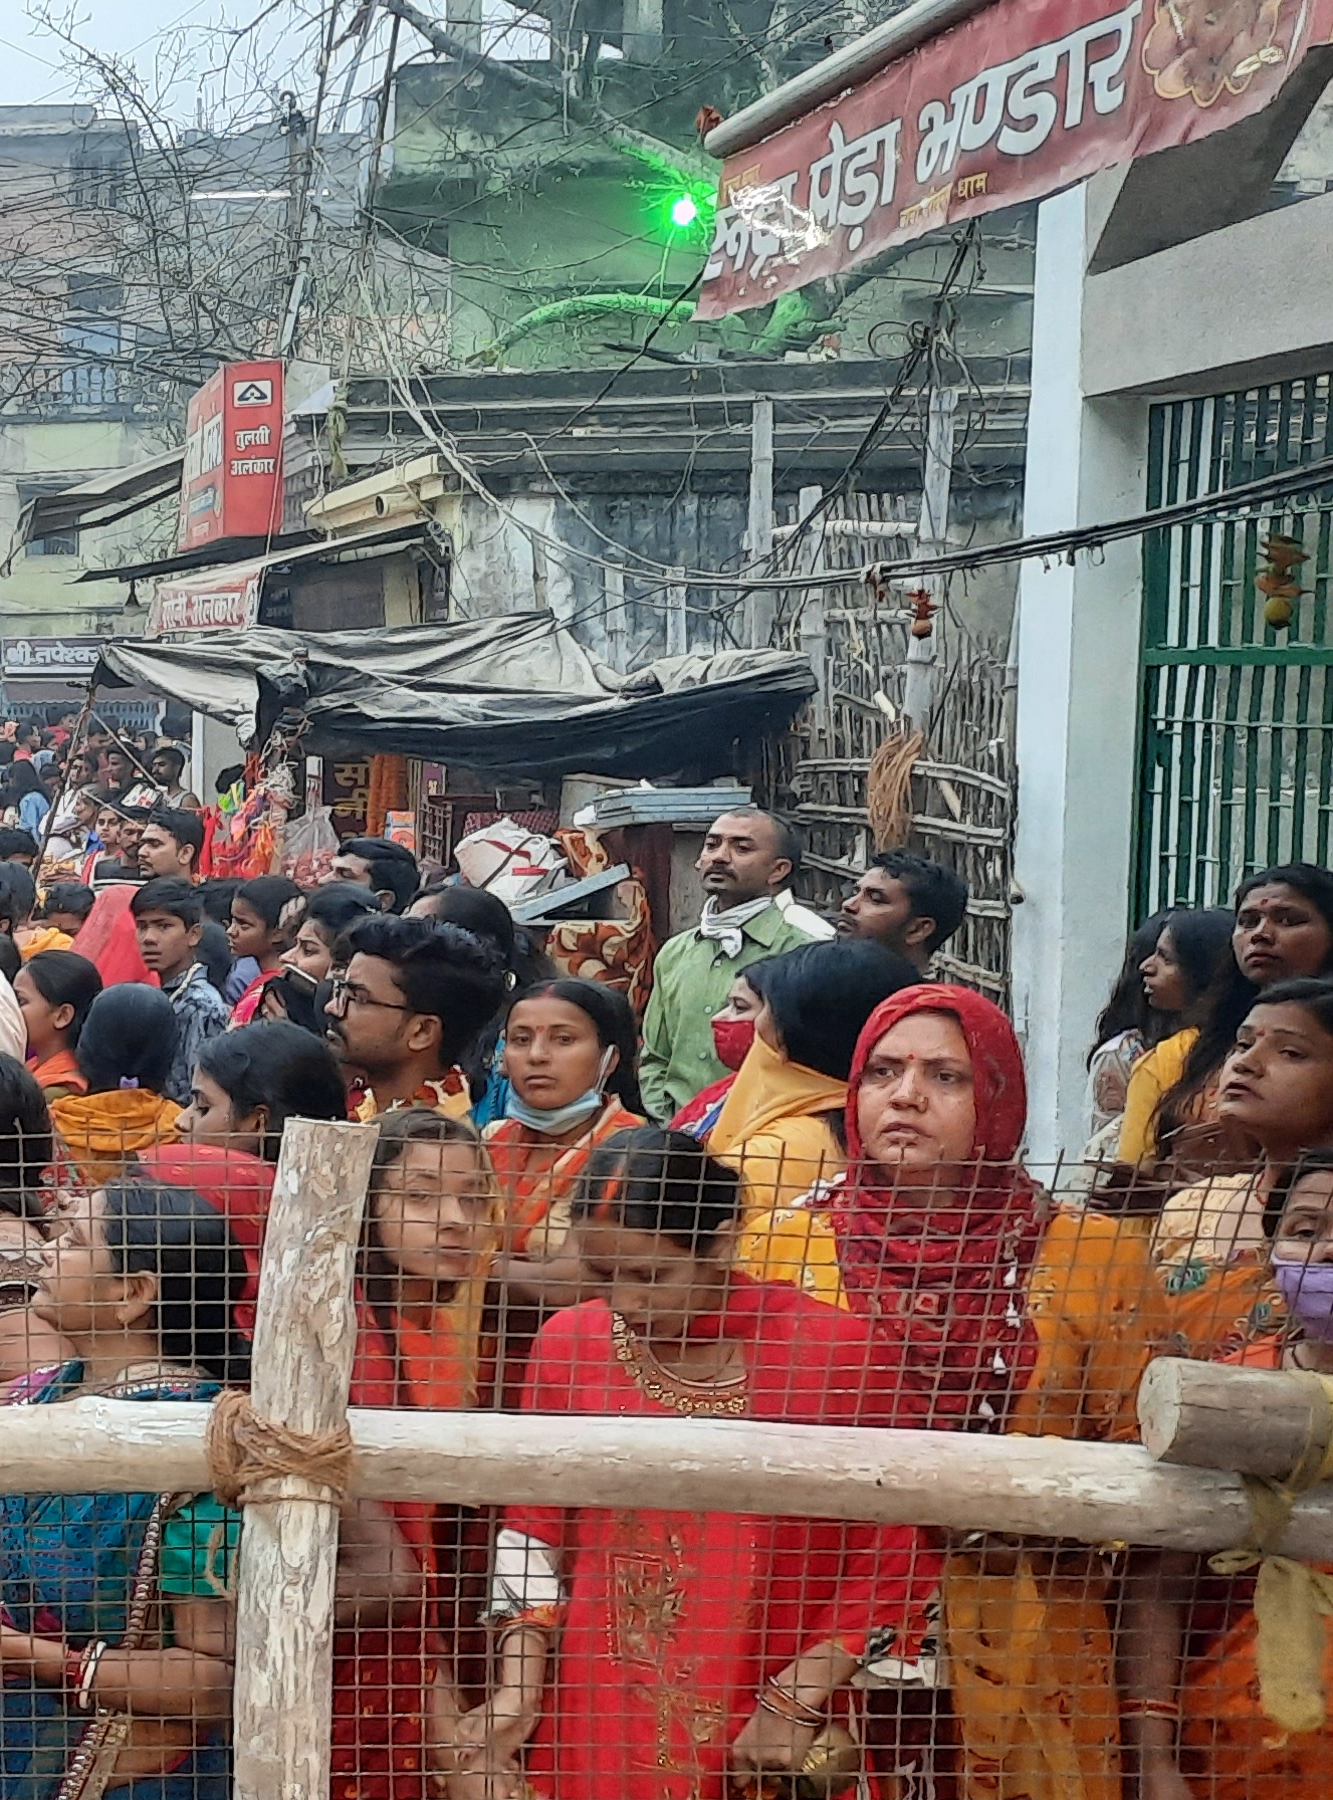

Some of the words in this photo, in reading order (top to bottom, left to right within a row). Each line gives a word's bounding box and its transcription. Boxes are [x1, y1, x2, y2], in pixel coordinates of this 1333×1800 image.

[809, 120, 903, 252] पेड़ा
[916, 5, 1141, 184] भण्डार
[234, 425, 271, 451] तुलसी
[230, 455, 276, 476] अलंकार
